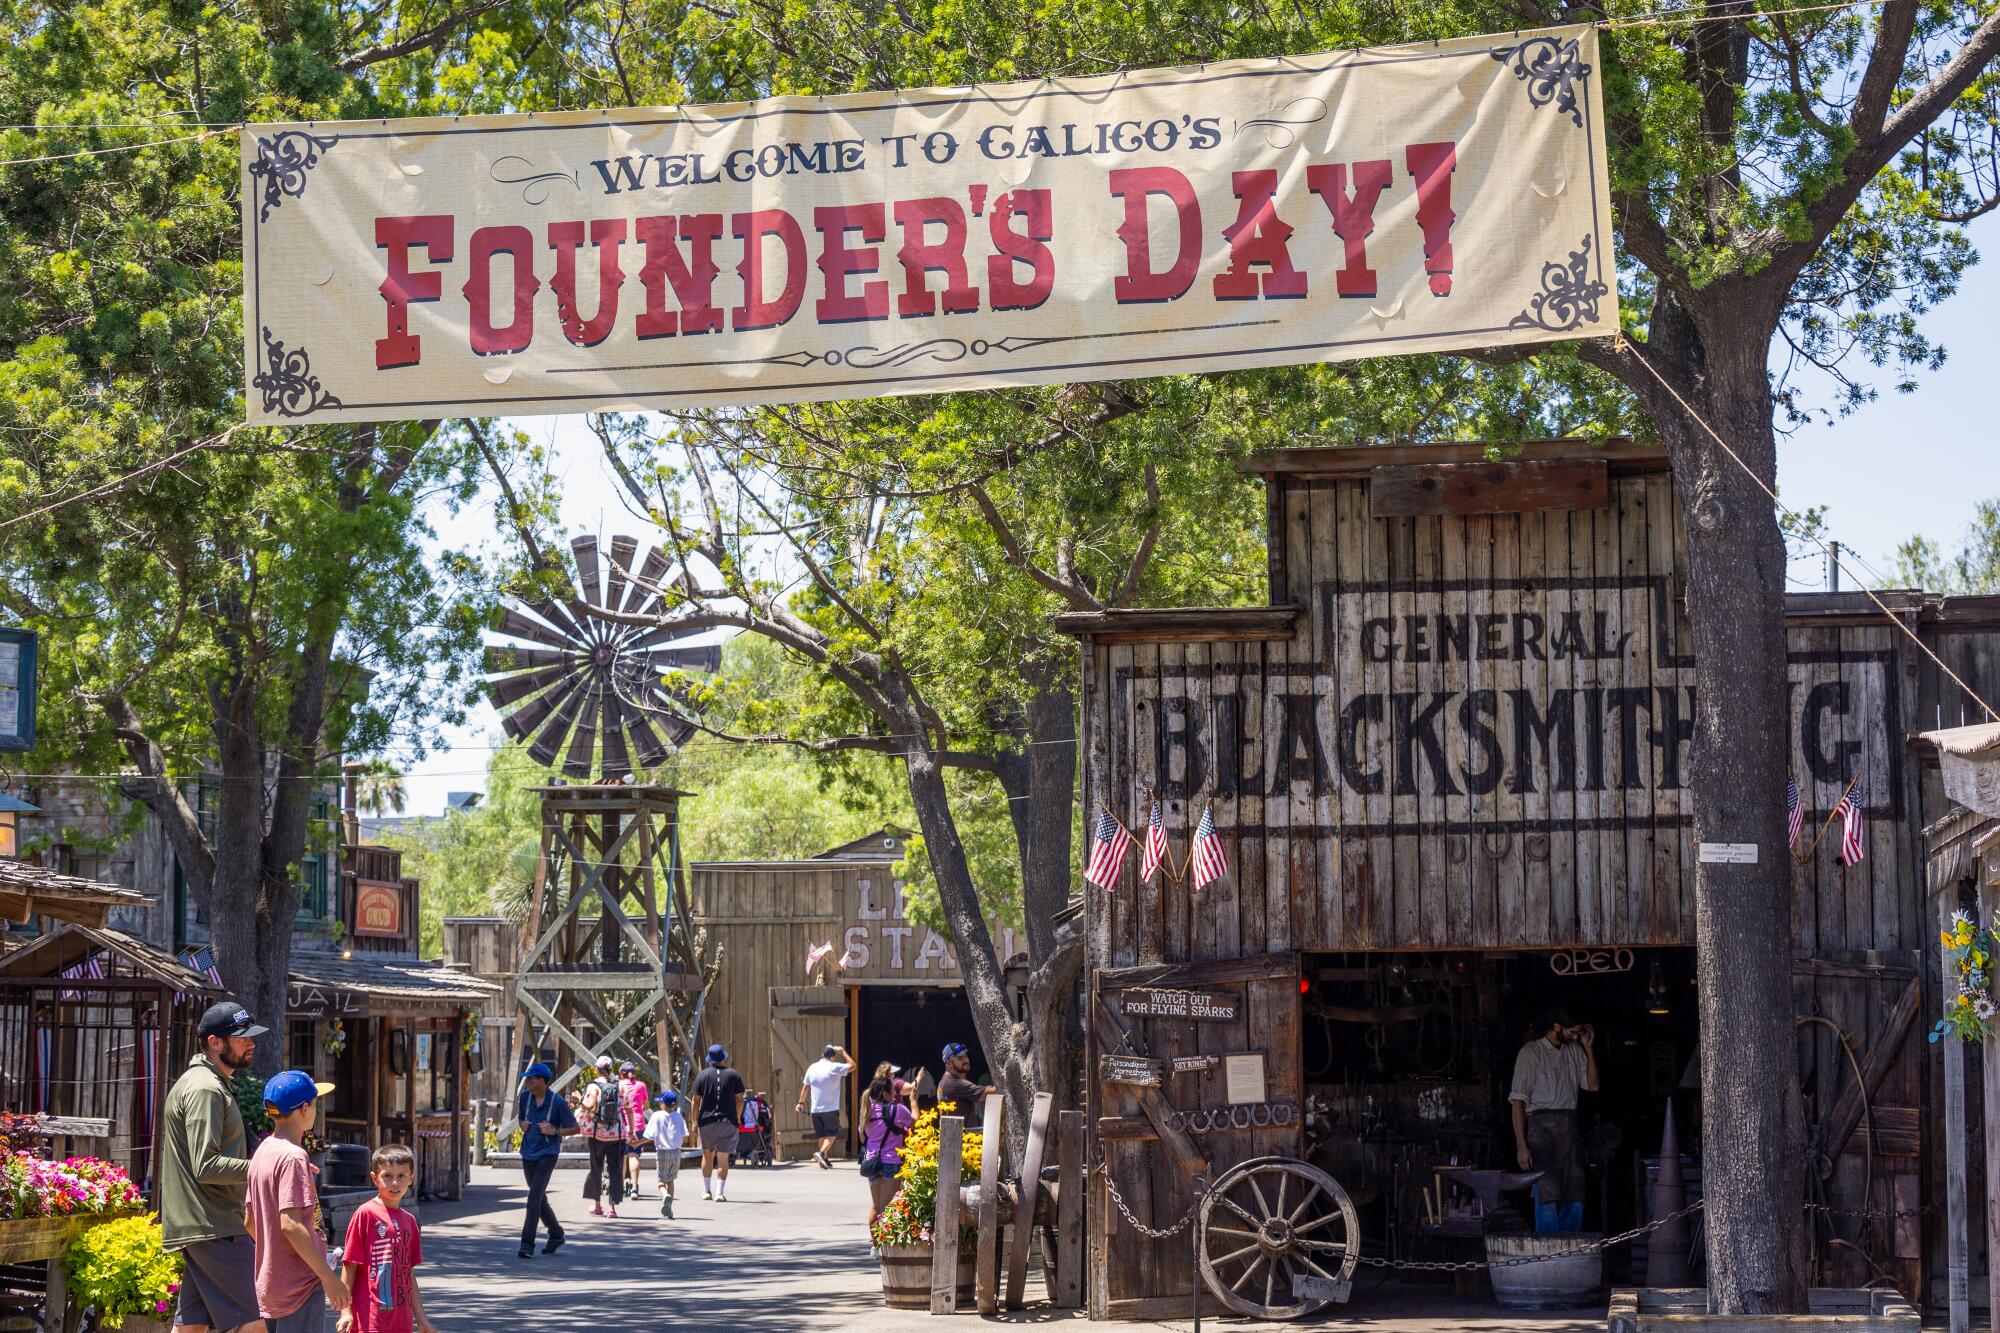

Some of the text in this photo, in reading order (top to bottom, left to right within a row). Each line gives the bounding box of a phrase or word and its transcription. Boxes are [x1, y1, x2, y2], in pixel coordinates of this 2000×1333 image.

[590, 114, 1222, 195] WELCOME TO CALICO'S
[375, 141, 1457, 371] FOUNDER'S DAY!
[1360, 610, 1636, 664] GENERAL
[1144, 680, 1867, 800] BLACKSMITHG
[1550, 947, 1635, 976] OPEN
[288, 984, 360, 1012] JAIL
[1126, 1002, 1235, 1018] FOR FLYING SPARKS
[1150, 992, 1212, 1006] WATCH OUT
